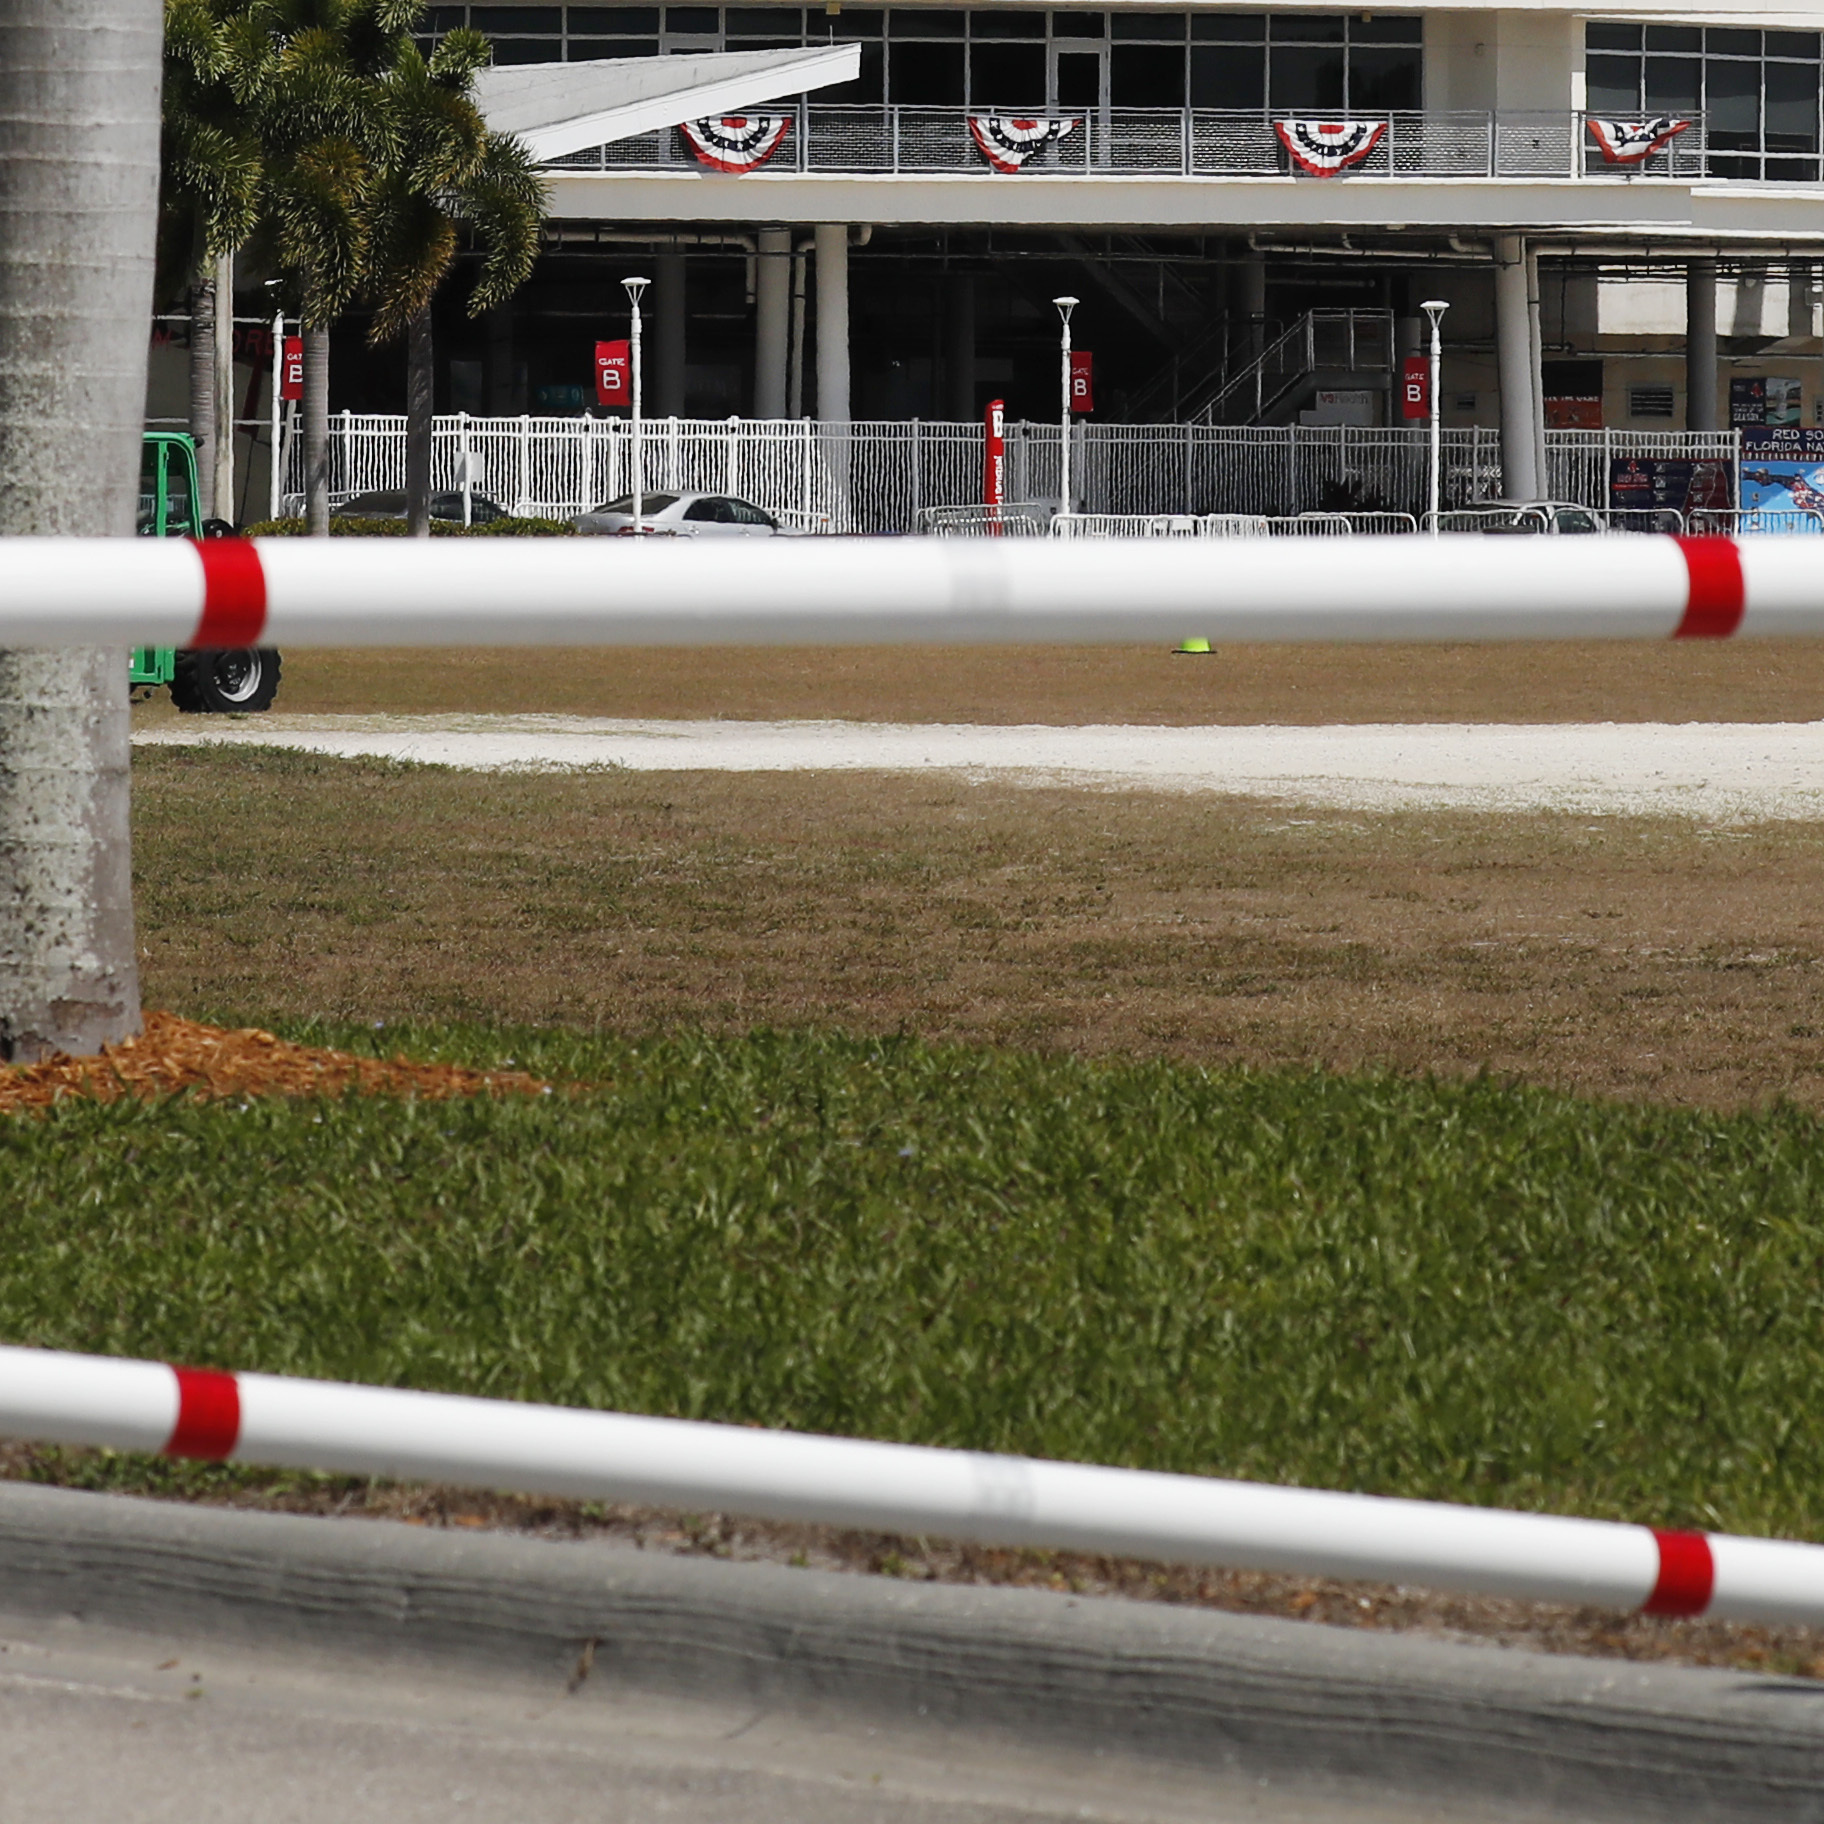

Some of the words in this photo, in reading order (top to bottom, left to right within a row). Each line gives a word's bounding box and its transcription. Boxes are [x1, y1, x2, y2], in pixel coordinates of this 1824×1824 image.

[287, 353, 302, 361] GAT
[598, 357, 626, 366] GATE
[602, 369, 621, 390] B
[1405, 373, 1425, 381] GATE
[1074, 378, 1087, 396] B
[1406, 384, 1422, 402] B
[1772, 428, 1800, 440] RED
[1745, 441, 1802, 451] FLORIDA
